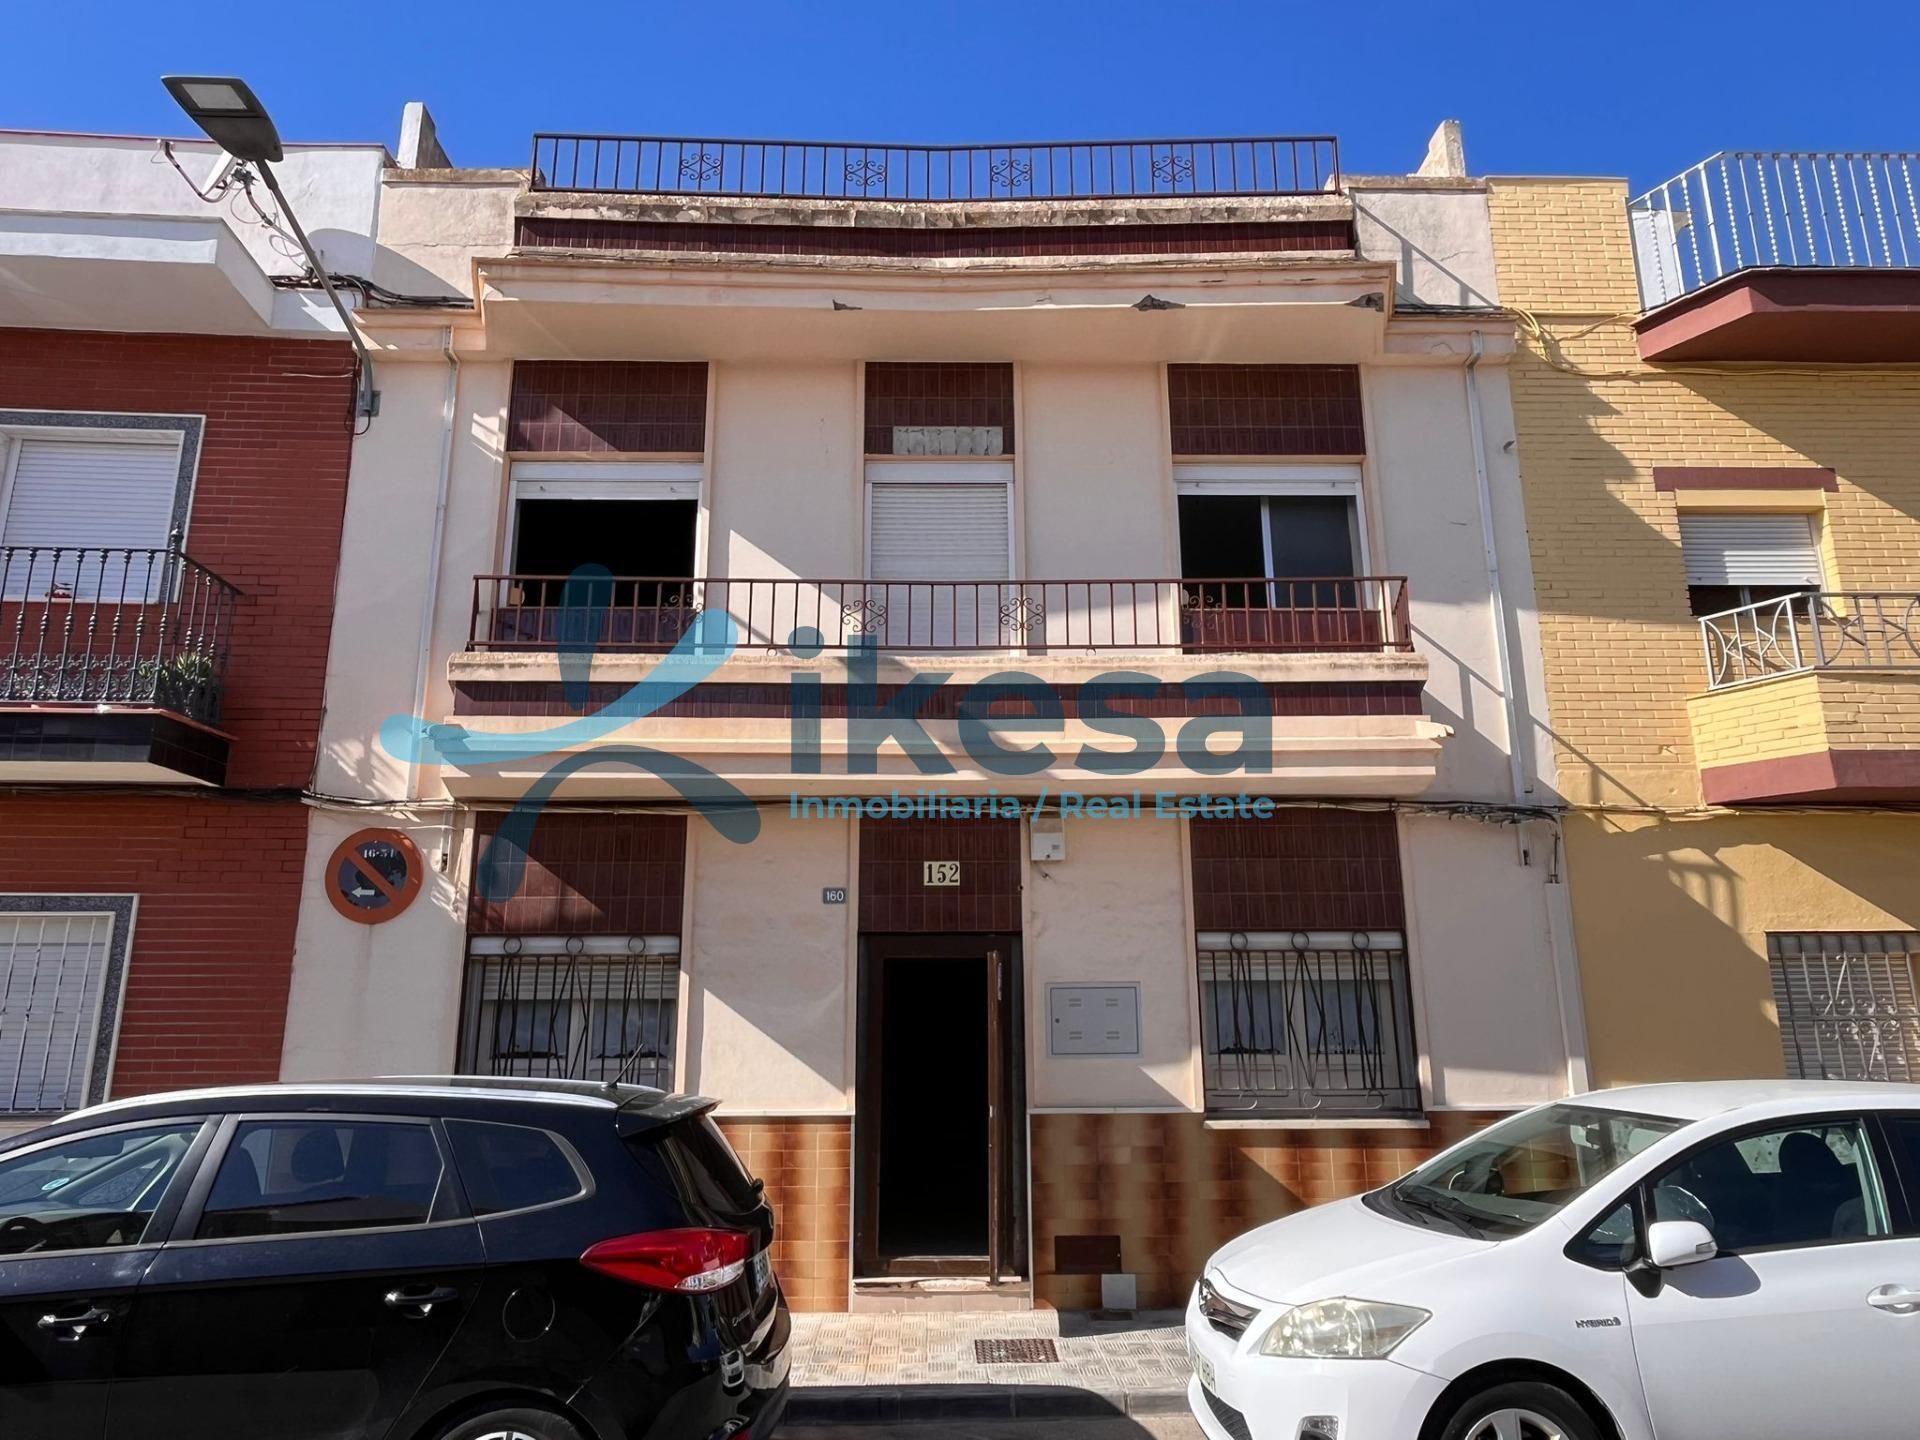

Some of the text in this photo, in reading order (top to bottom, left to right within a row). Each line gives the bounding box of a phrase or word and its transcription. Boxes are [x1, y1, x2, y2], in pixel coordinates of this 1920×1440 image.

[926, 863, 959, 884] 152
[826, 890, 844, 902] 160
[1575, 1318, 1614, 1328] HYBRID
